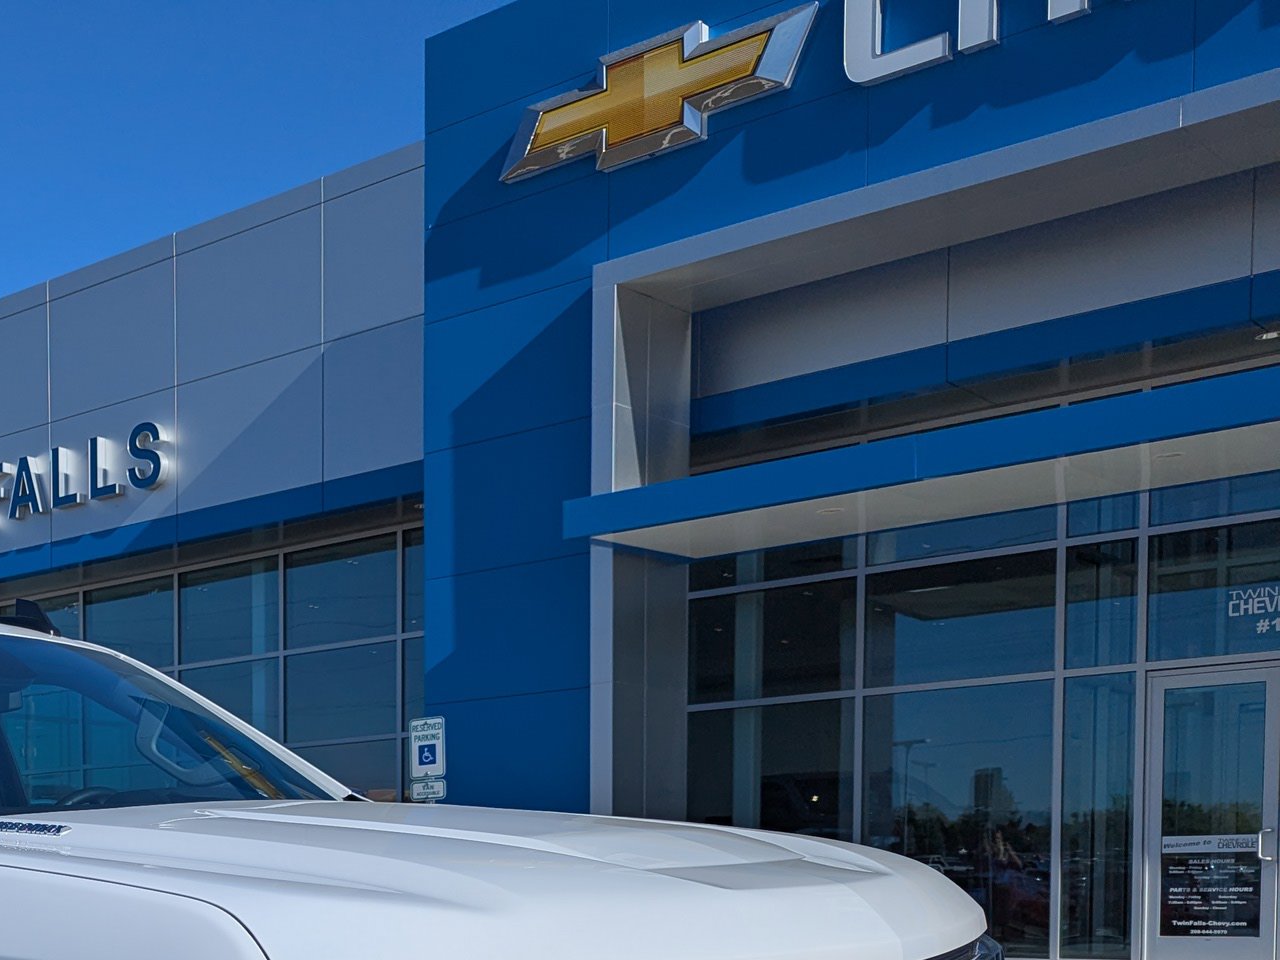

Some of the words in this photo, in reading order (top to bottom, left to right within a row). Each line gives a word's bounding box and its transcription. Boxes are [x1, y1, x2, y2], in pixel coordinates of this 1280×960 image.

[1228, 596, 1280, 617] CHEV
[411, 722, 442, 733] RESERVED
[413, 733, 441, 743] PARKING
[1163, 841, 1201, 849] Welcome
